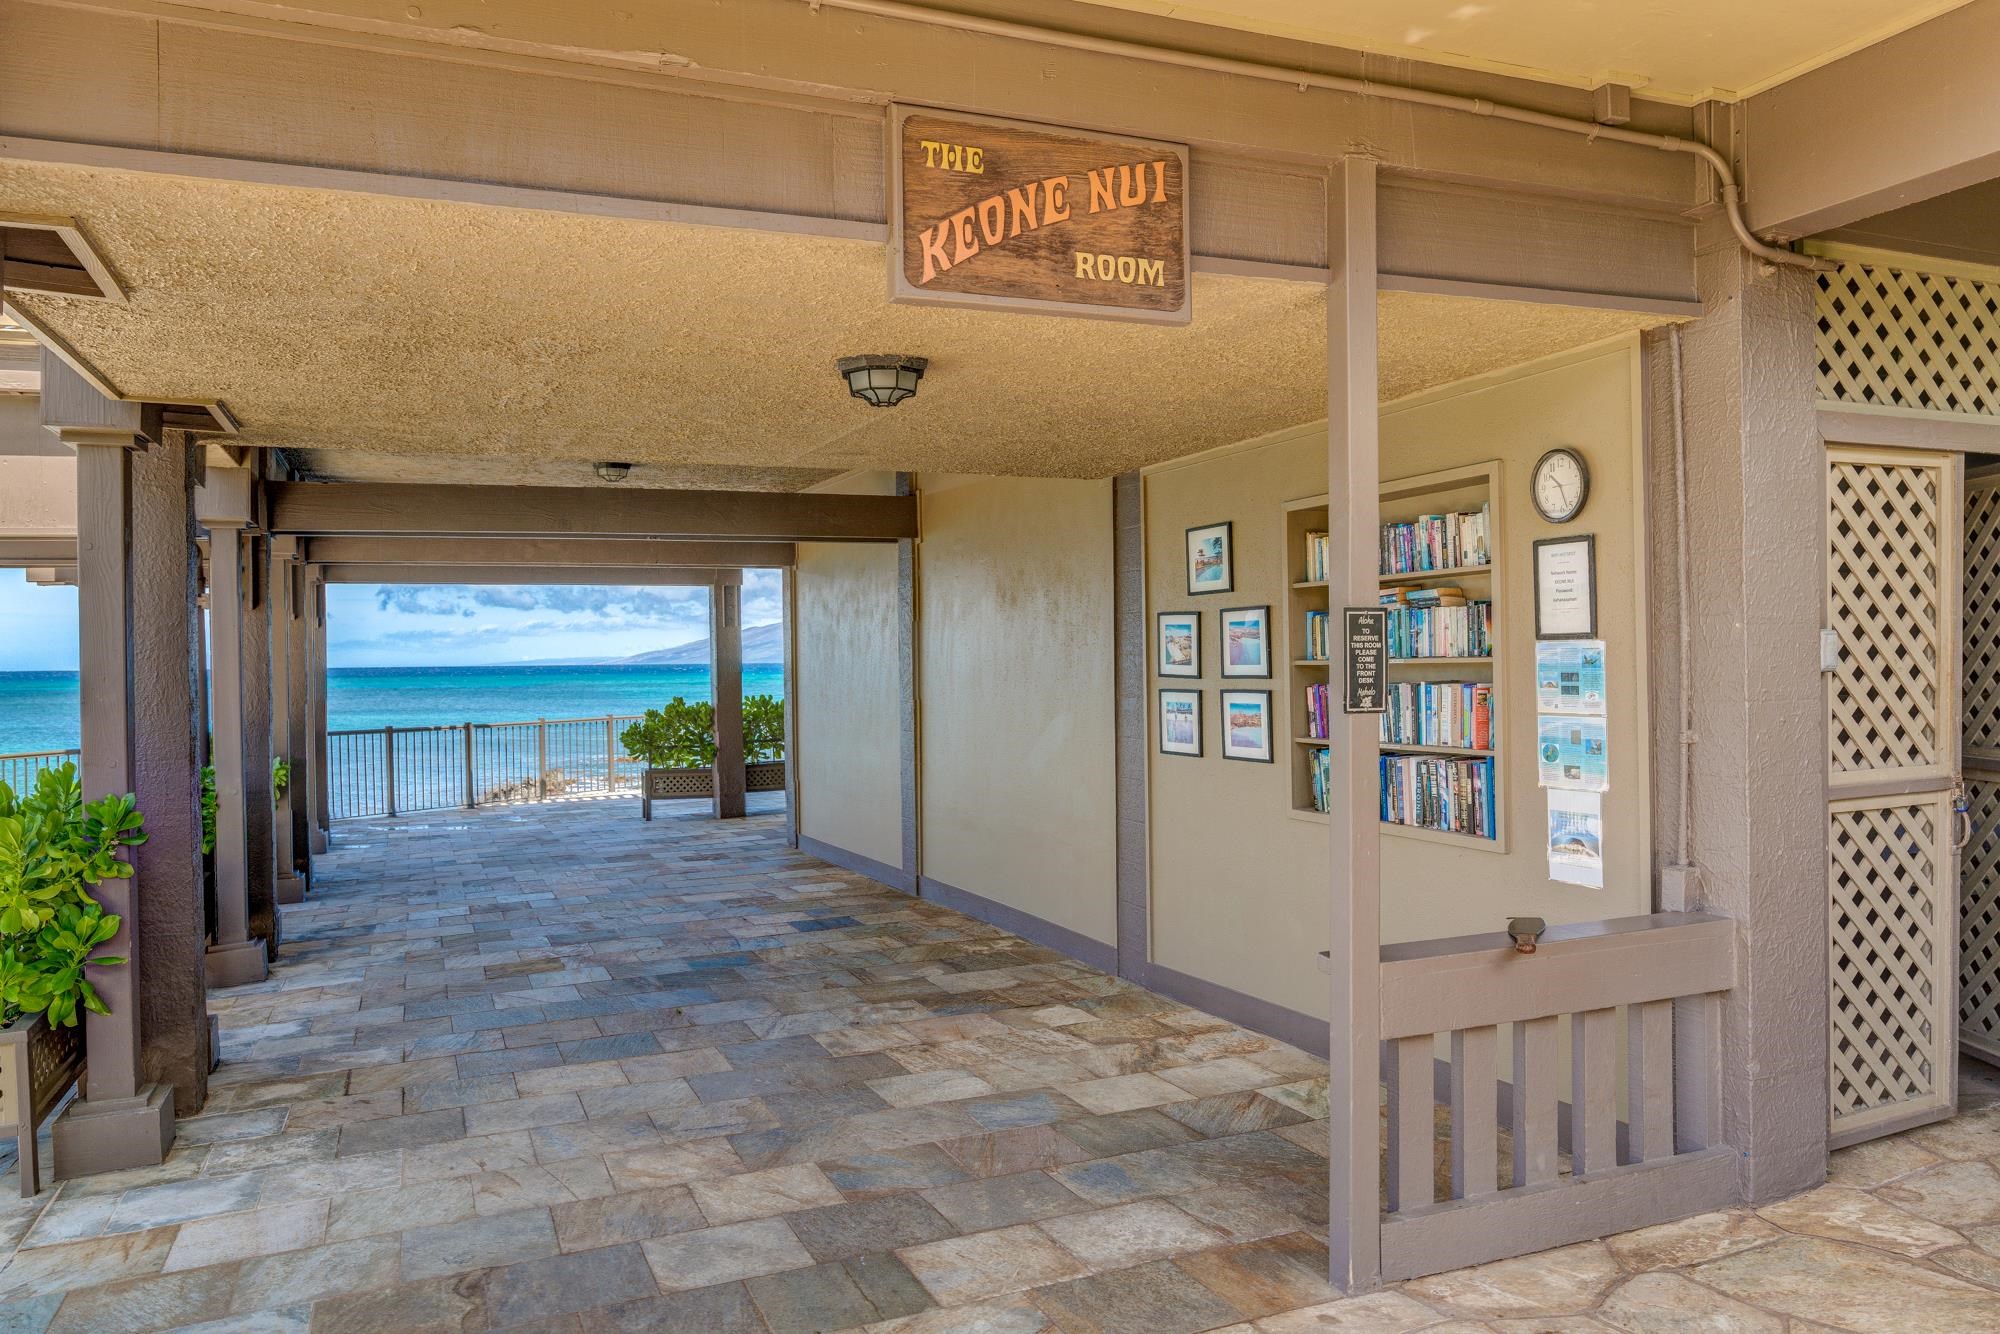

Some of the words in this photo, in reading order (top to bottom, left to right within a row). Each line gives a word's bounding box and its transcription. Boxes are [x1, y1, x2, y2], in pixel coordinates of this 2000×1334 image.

[920, 140, 984, 175] THE
[918, 175, 1071, 284] KEONE
[1087, 161, 1168, 215] NUI
[1074, 251, 1165, 287] ROOM
